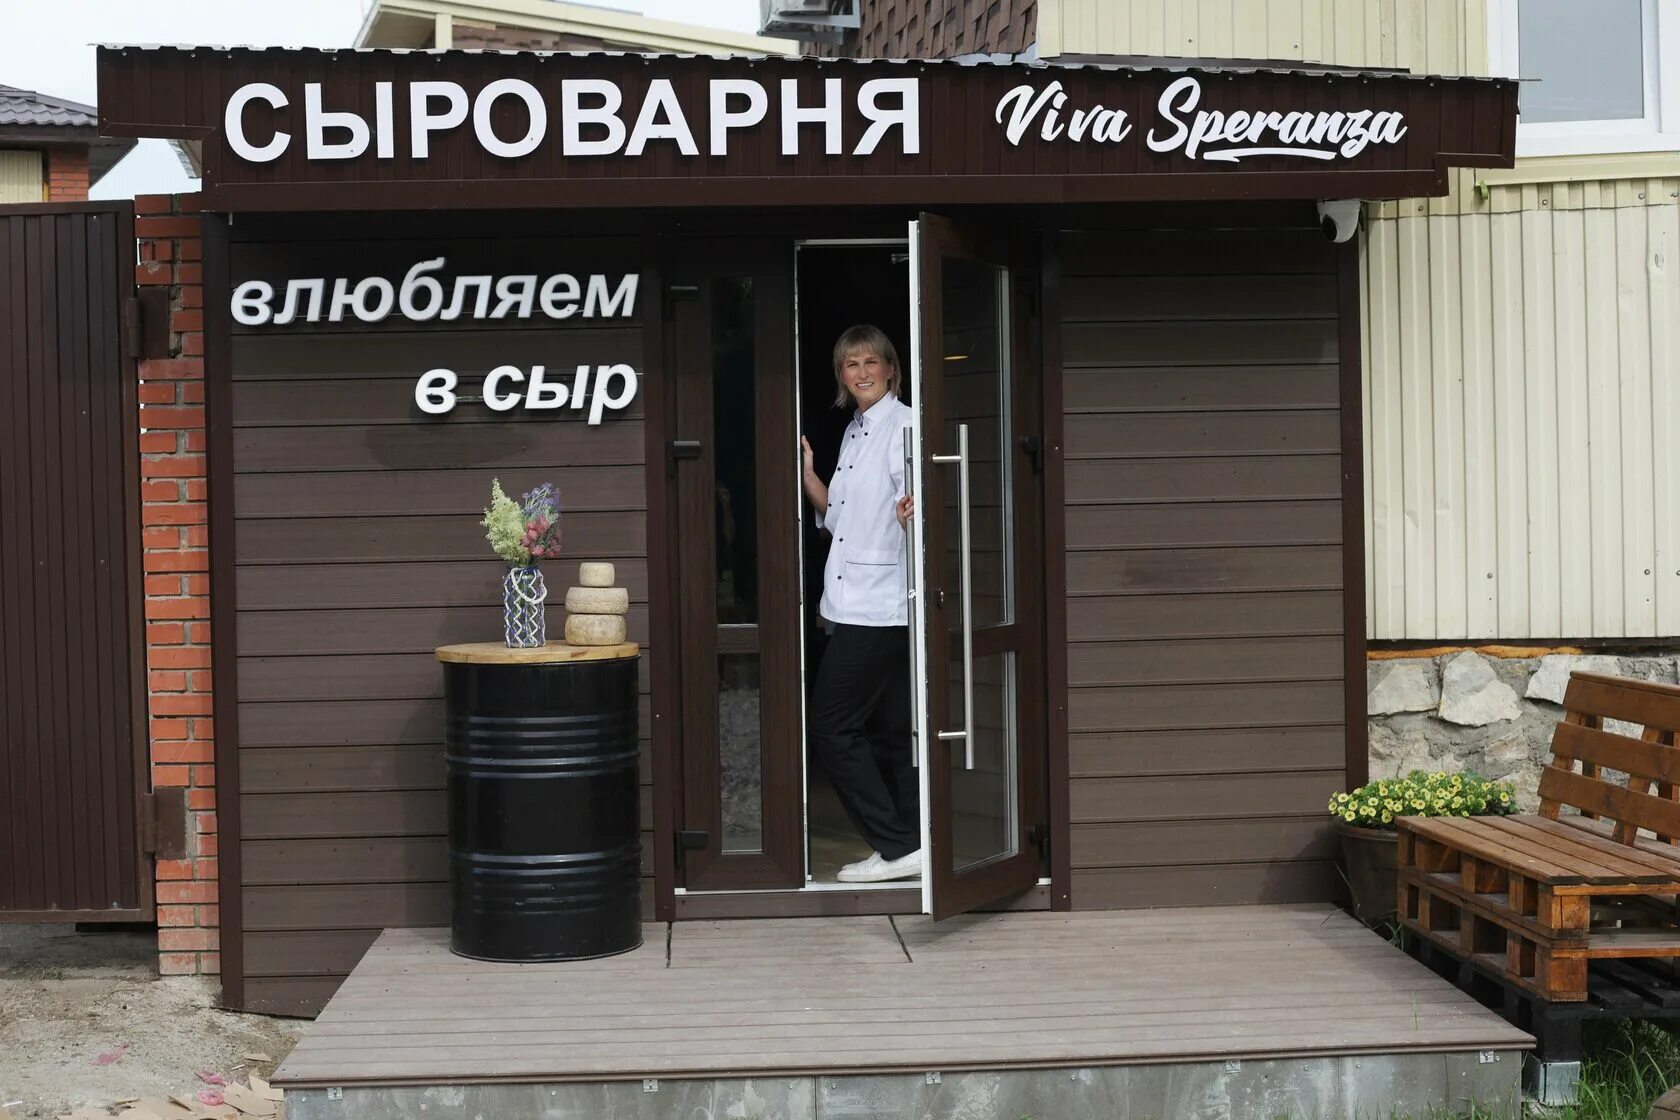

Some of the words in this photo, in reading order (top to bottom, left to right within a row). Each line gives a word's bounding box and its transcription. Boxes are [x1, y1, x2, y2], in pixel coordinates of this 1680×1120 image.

[224, 77, 921, 163] СЫРОВАРНЯ
[995, 80, 1132, 146] Viva
[1146, 76, 1408, 162] Speranza
[230, 257, 639, 326] влюбляем
[414, 367, 457, 415] в
[482, 363, 639, 426] сыр
